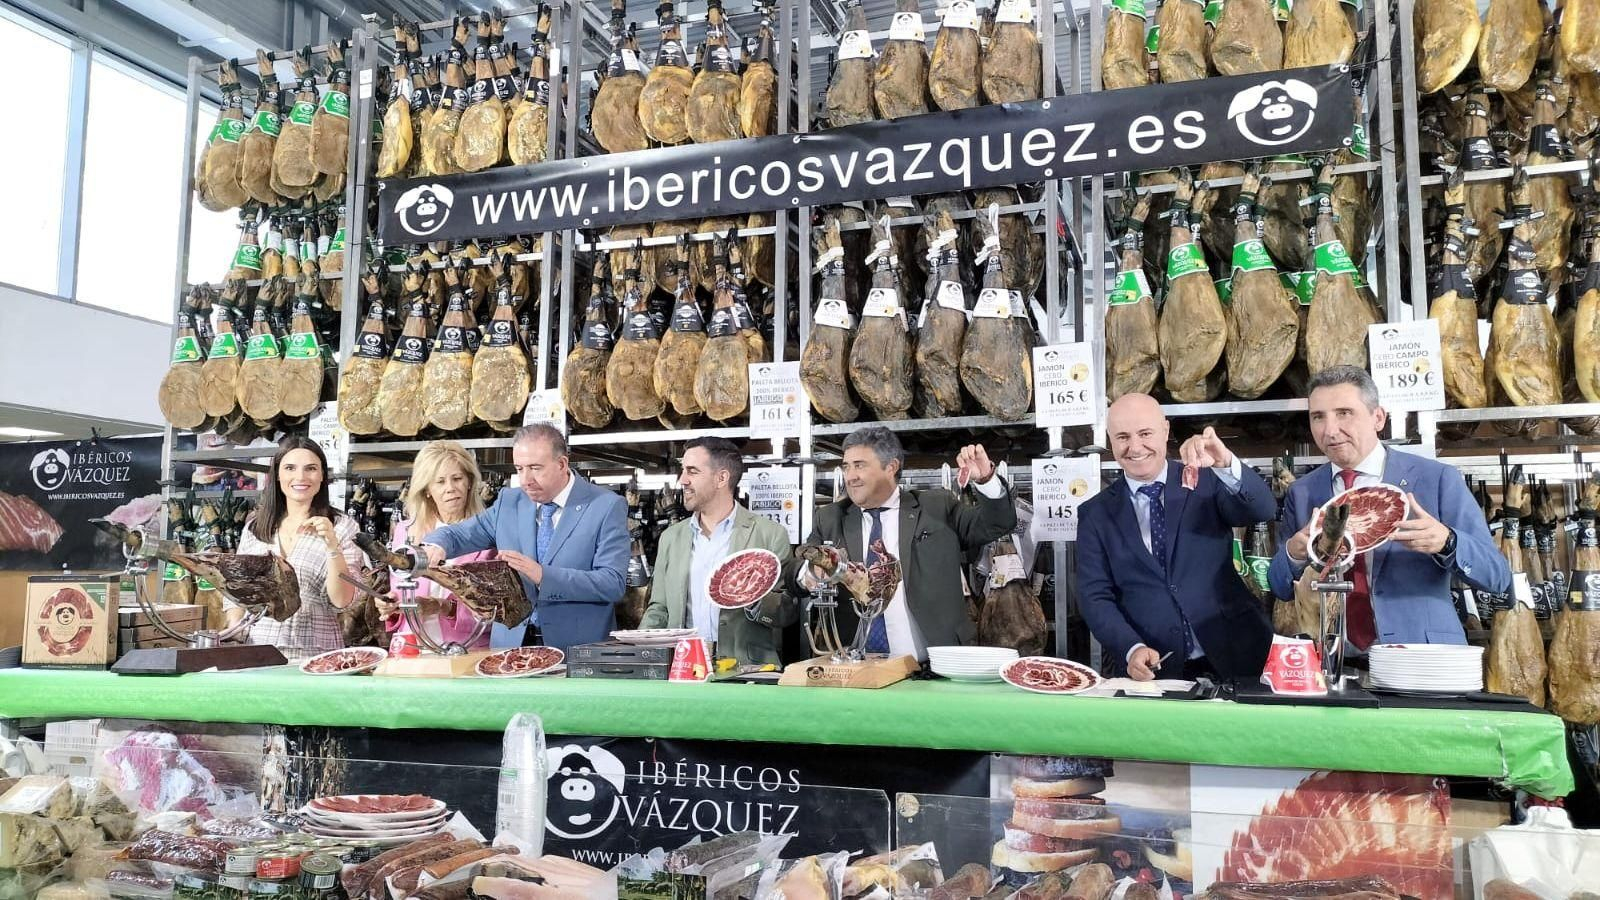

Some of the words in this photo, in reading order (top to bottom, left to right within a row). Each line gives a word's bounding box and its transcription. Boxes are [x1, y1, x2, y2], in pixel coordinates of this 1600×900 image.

[471, 109, 1208, 226] www.ibericosvazquez.es
[1396, 350, 1429, 360] CAMPO
[1388, 373, 1418, 388] 189
[1423, 371, 1435, 387] €
[1049, 391, 1075, 405] 165
[1079, 390, 1088, 403] €
[762, 407, 781, 420] 161
[786, 407, 796, 419] €
[73, 450, 133, 465] IBÉRICOS
[67, 465, 131, 485] VÁZQUEZ
[47, 492, 125, 501] WWW.IBERICOSVAZQUEZ.ES
[1048, 505, 1073, 519] 145
[636, 757, 801, 794] IBÉRICOS
[619, 789, 801, 838] VÁZQUEZ
